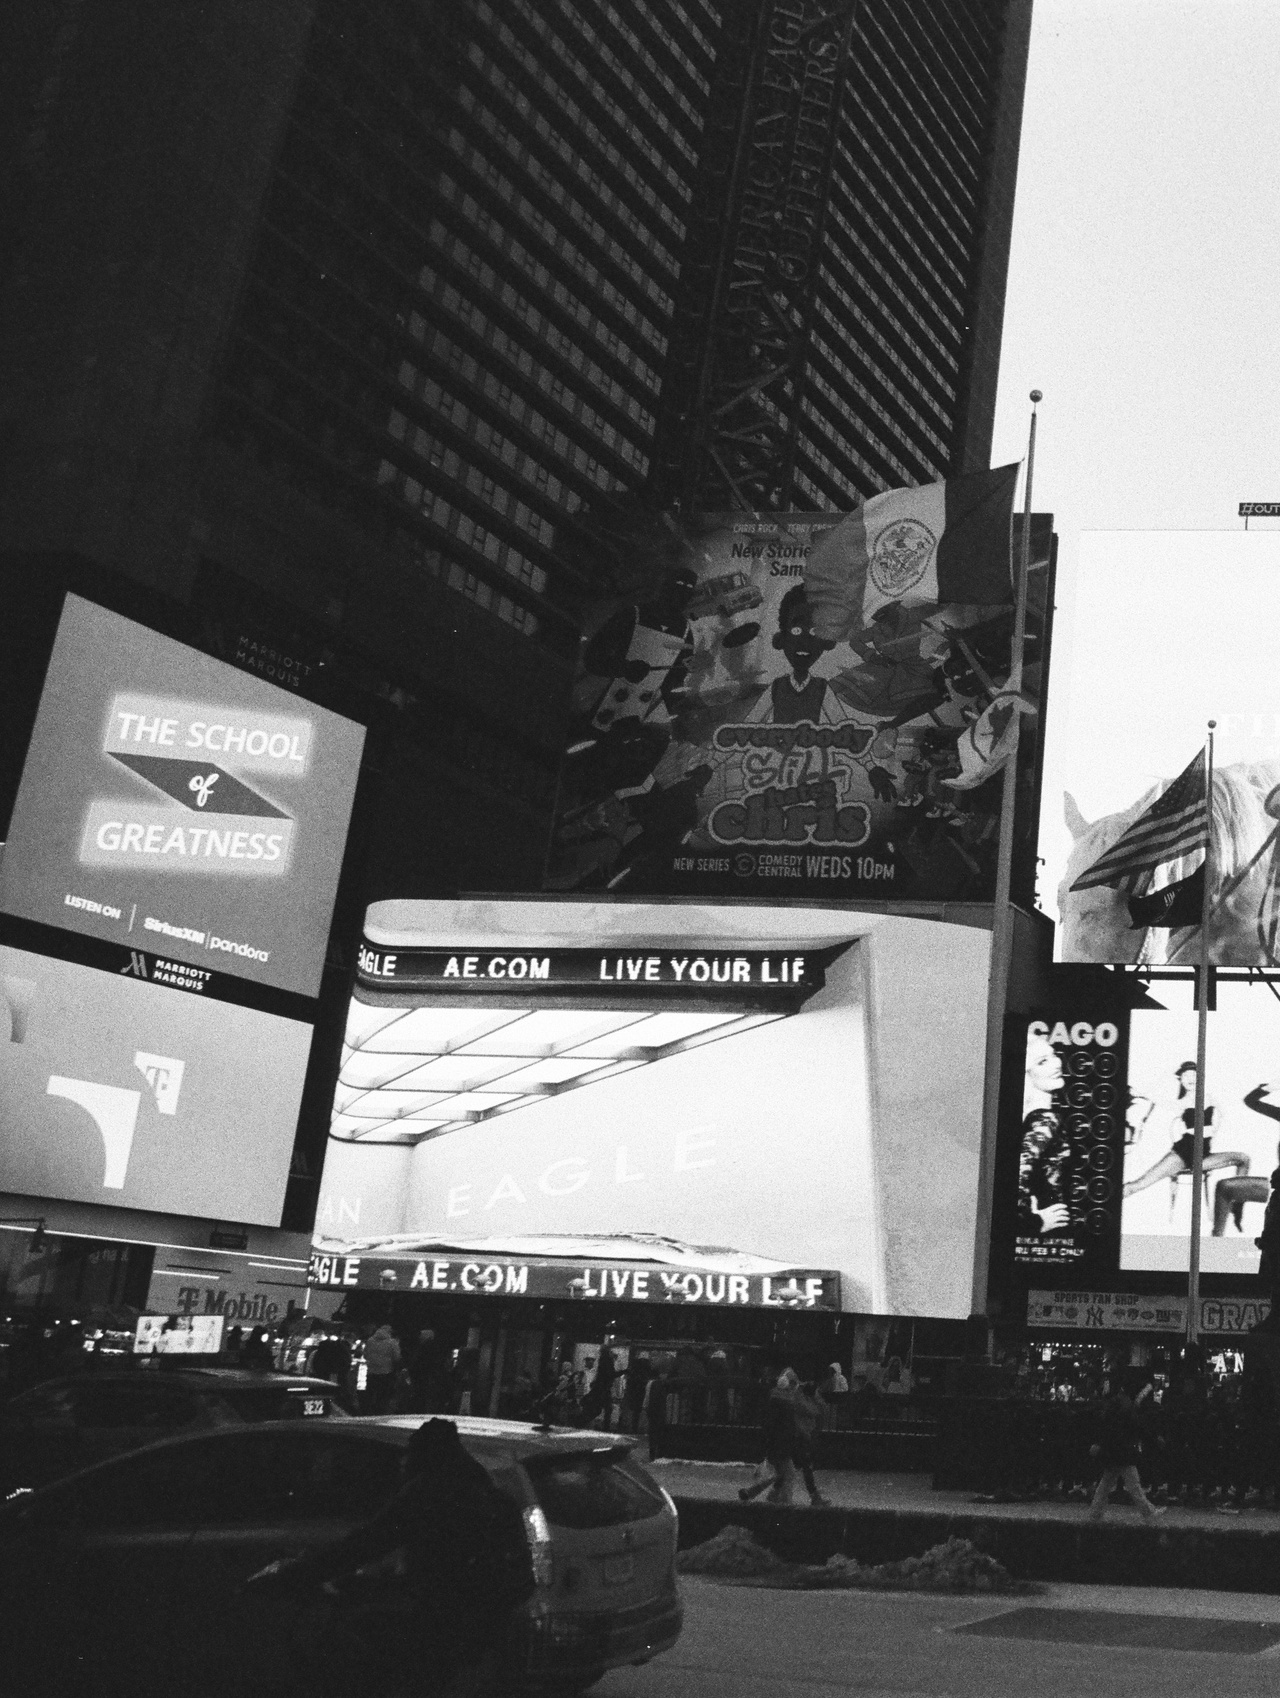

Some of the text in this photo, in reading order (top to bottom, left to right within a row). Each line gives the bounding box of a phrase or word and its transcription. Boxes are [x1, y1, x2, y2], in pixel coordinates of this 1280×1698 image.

[725, 105, 790, 326] AMERICAN
[758, 523, 779, 532] ROCK
[731, 543, 811, 558] New Storie
[769, 560, 804, 577] Sam
[235, 650, 301, 687] MARQUIS
[238, 635, 312, 676] MARRIOTT
[117, 712, 306, 763] THE SCHOOL
[716, 722, 874, 754] everybody
[187, 772, 220, 807] of
[96, 820, 284, 863] GREATNESS
[673, 857, 730, 872] NEW SERIES
[757, 866, 802, 878] CENTRAL
[758, 854, 803, 867] COMEDY
[806, 855, 895, 880] WEDS 10PM
[64, 894, 122, 920] LISTEN ON
[144, 917, 269, 962] SiriusXM pandora
[153, 970, 204, 991] MARQUIS
[156, 959, 212, 981] MARRIOTT
[443, 957, 550, 979] AE.COM
[600, 957, 660, 981] LIVE
[670, 957, 751, 983] YOUR
[762, 957, 805, 984] LIF
[446, 1123, 718, 1219] EAGLE
[410, 1264, 528, 1294] AE.COM
[583, 1269, 650, 1300] LIVE
[205, 1289, 279, 1322] Mobile
[1054, 1292, 1139, 1305] SPORTS FAN SHOP
